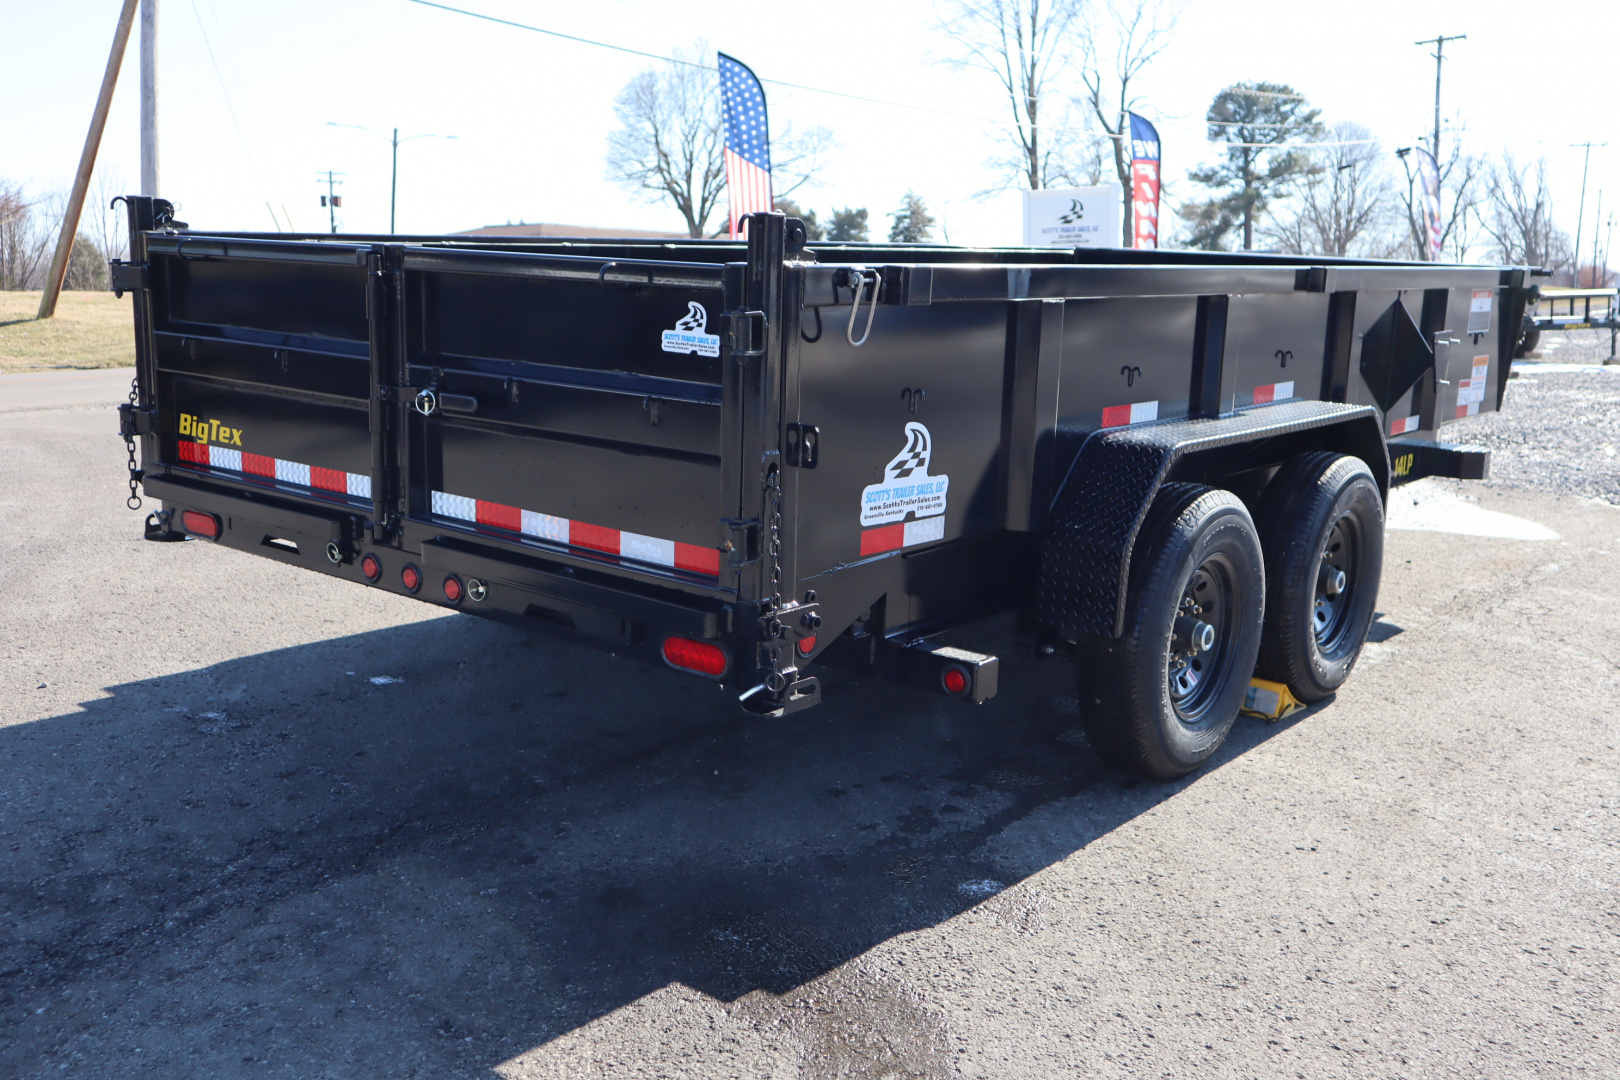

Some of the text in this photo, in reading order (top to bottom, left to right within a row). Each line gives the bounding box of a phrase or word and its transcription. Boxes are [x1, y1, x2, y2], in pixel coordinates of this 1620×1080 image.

[179, 412, 243, 446] BigTex
[1394, 453, 1414, 478] 14LP
[865, 481, 945, 504] SCOTT'S TRAILER SALES, LLC
[869, 495, 941, 512] www.ScottsTrailerSales.com
[631, 540, 662, 554] BigTex
